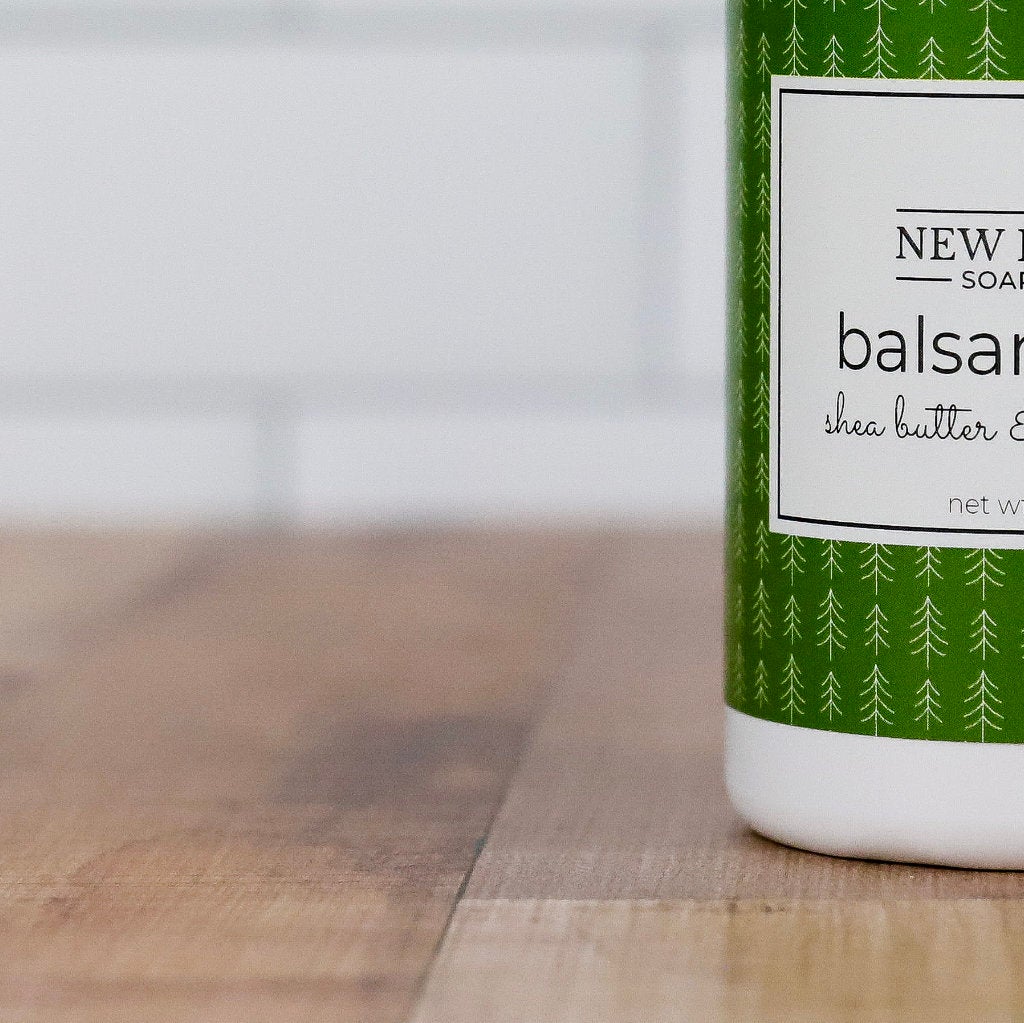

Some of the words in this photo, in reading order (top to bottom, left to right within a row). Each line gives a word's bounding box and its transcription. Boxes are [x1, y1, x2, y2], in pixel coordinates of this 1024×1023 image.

[895, 226, 1006, 262] NEW
[824, 390, 887, 438] shea
[893, 393, 999, 442] butter
[948, 494, 990, 516] net
